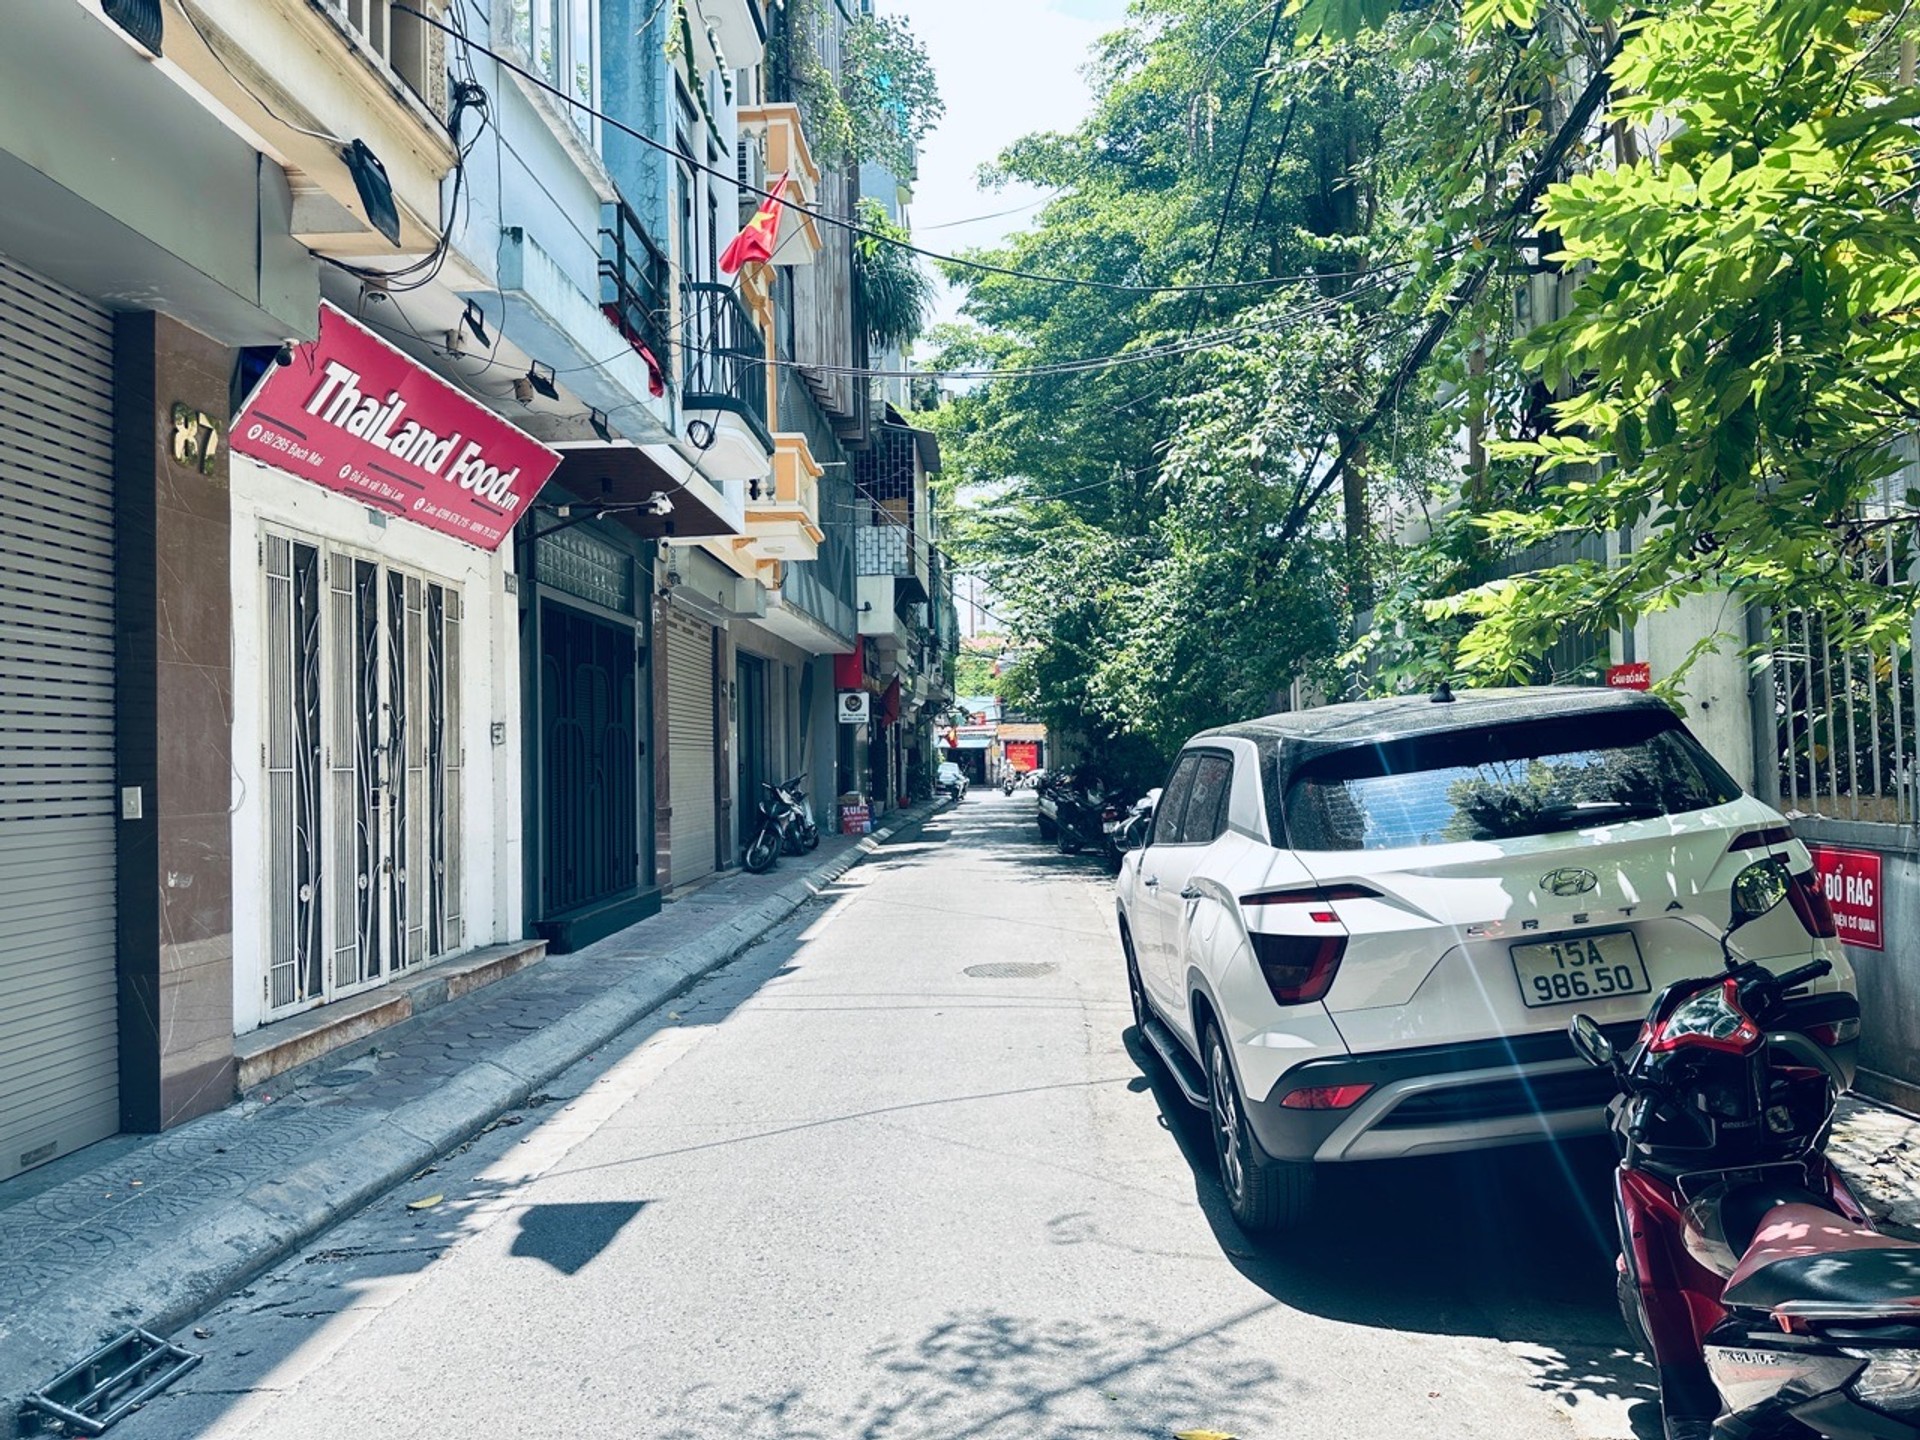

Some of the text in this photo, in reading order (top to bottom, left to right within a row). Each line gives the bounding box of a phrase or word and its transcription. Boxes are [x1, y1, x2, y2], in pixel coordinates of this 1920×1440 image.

[306, 361, 461, 474] ThaiLand
[170, 401, 222, 475] 87
[306, 451, 326, 466] Mai
[1825, 863, 1844, 902] ĐỔ
[1846, 871, 1874, 907] RÁC
[1467, 900, 1684, 938] CRETA
[1858, 917, 1876, 933] QUAN
[1550, 939, 1603, 969] 15A
[1533, 965, 1634, 1001] 986.50
